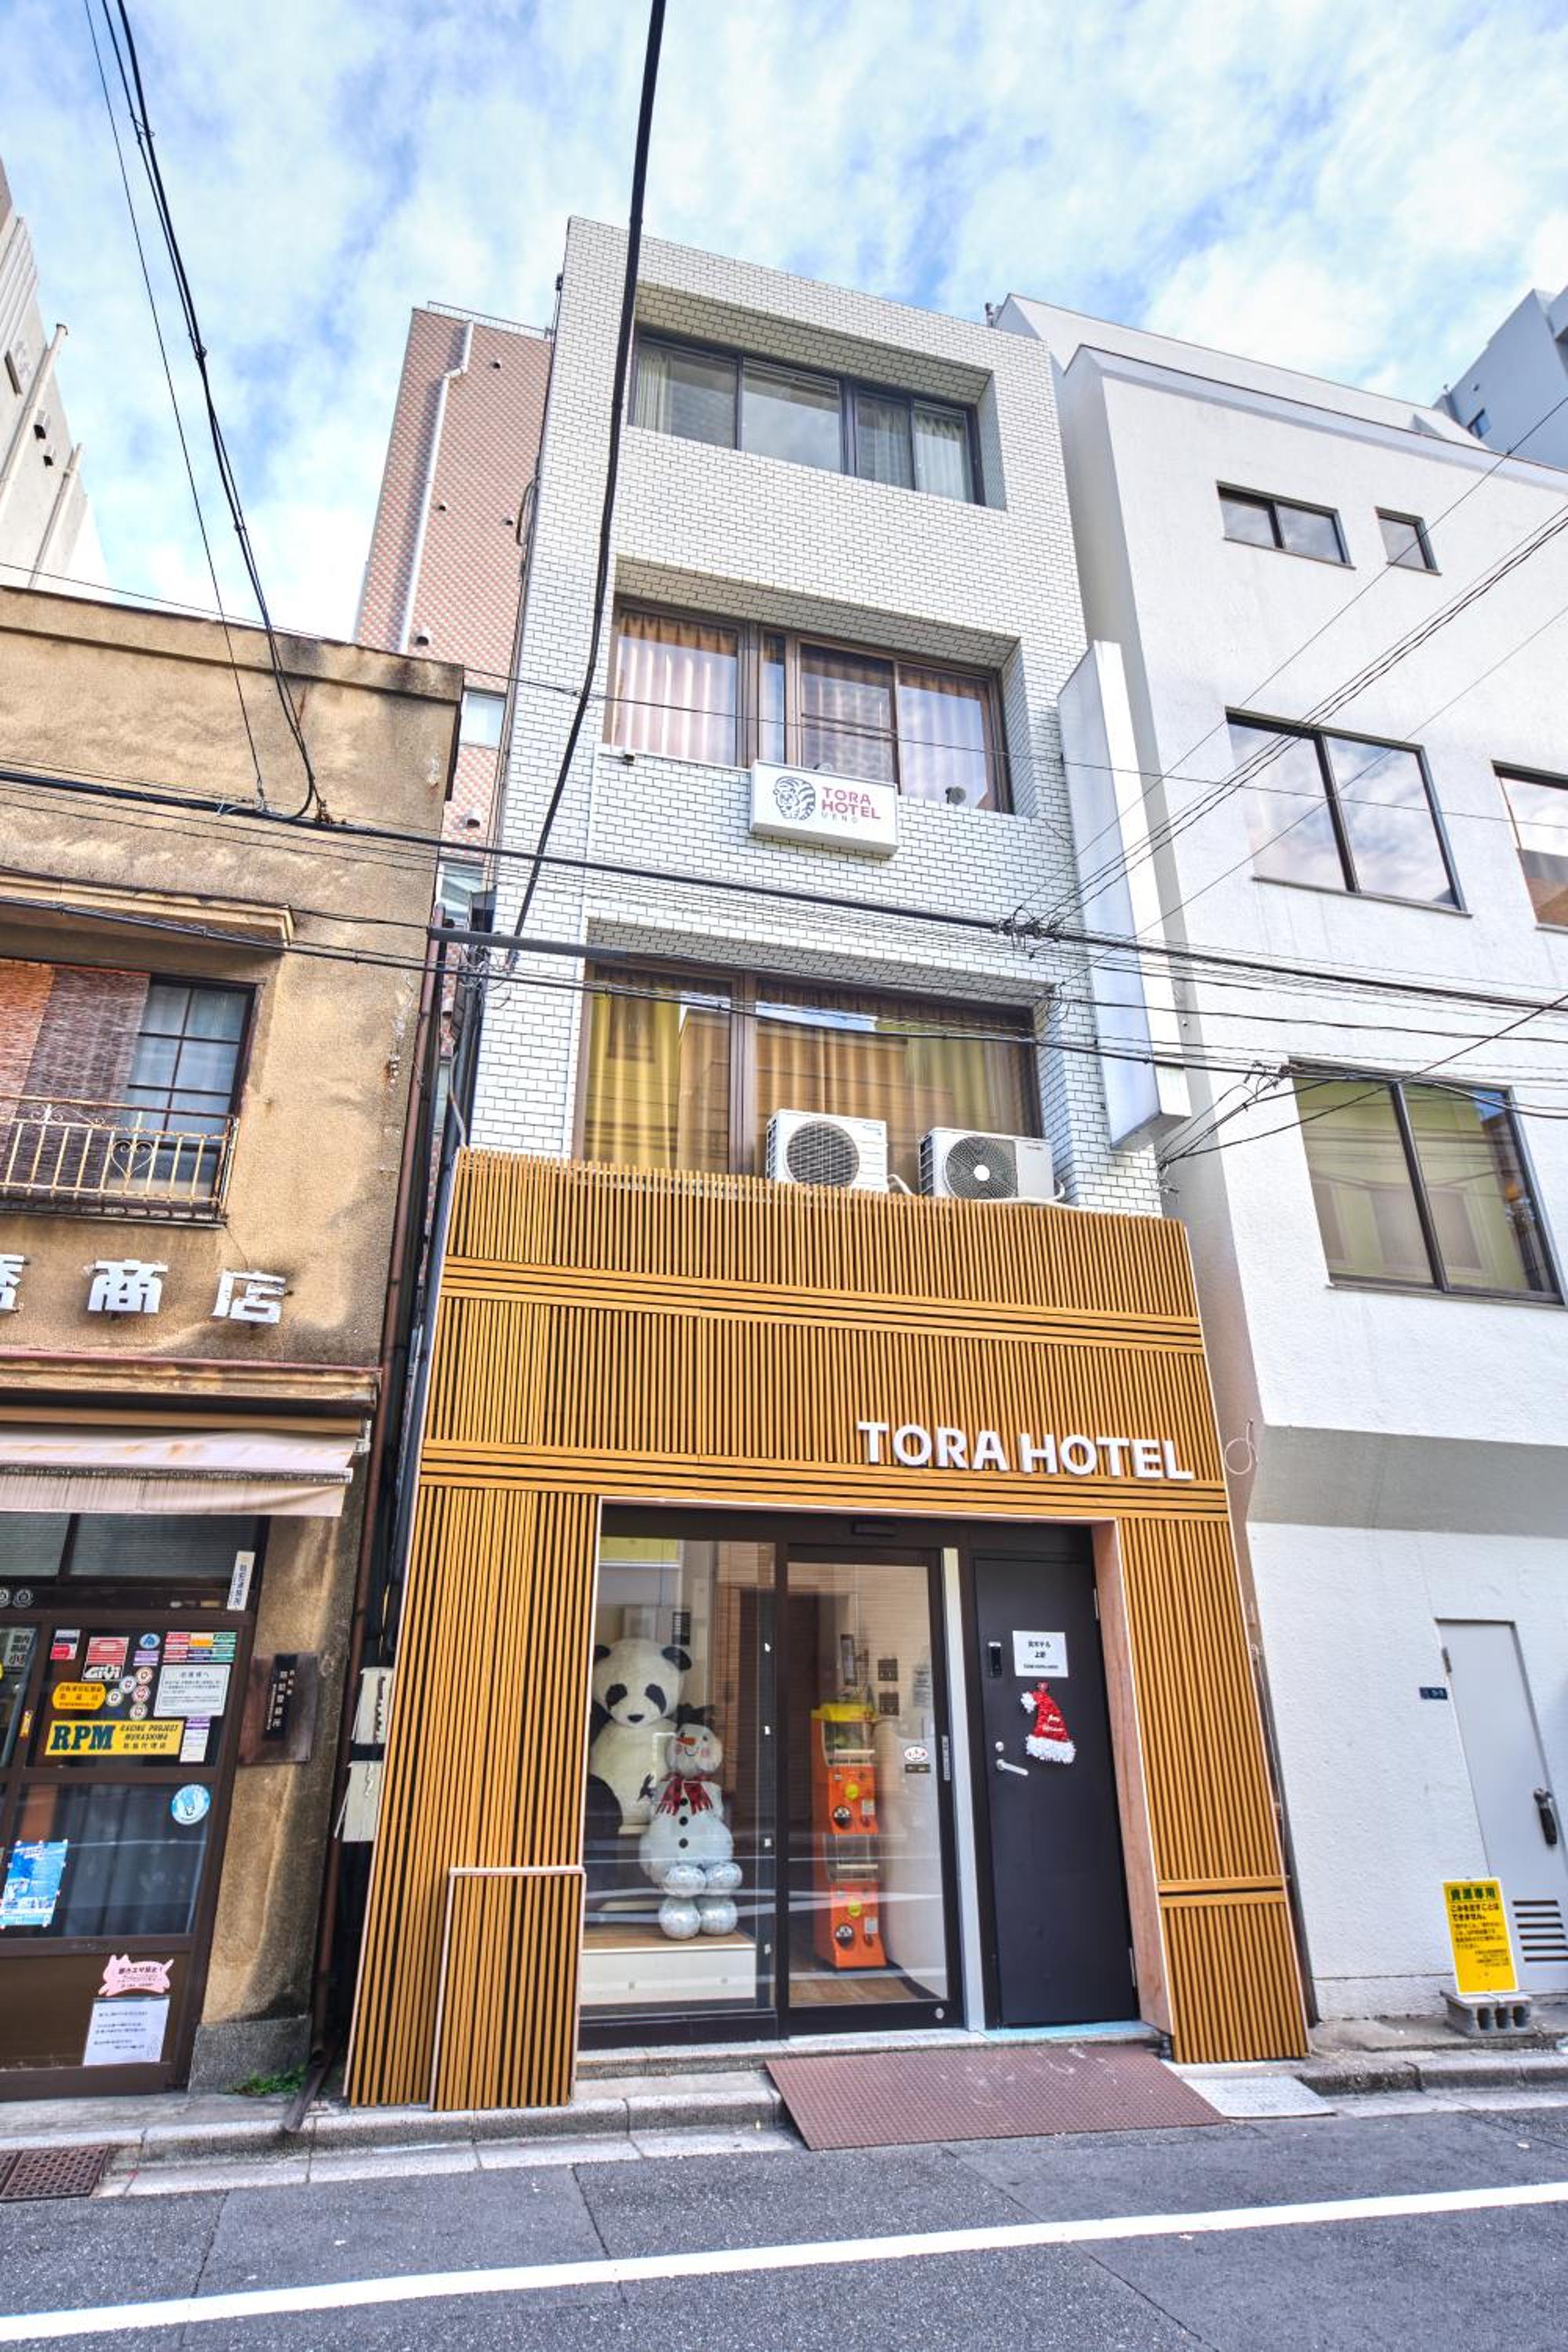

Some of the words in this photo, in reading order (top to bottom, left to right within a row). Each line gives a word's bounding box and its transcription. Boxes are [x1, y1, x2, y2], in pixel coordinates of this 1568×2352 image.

[822, 786, 871, 805] TORA
[822, 799, 881, 819] HOTEL
[858, 1421, 1009, 1471] TORA
[1020, 1432, 1194, 1480] HOTEL
[50, 1724, 116, 1751] RPM
